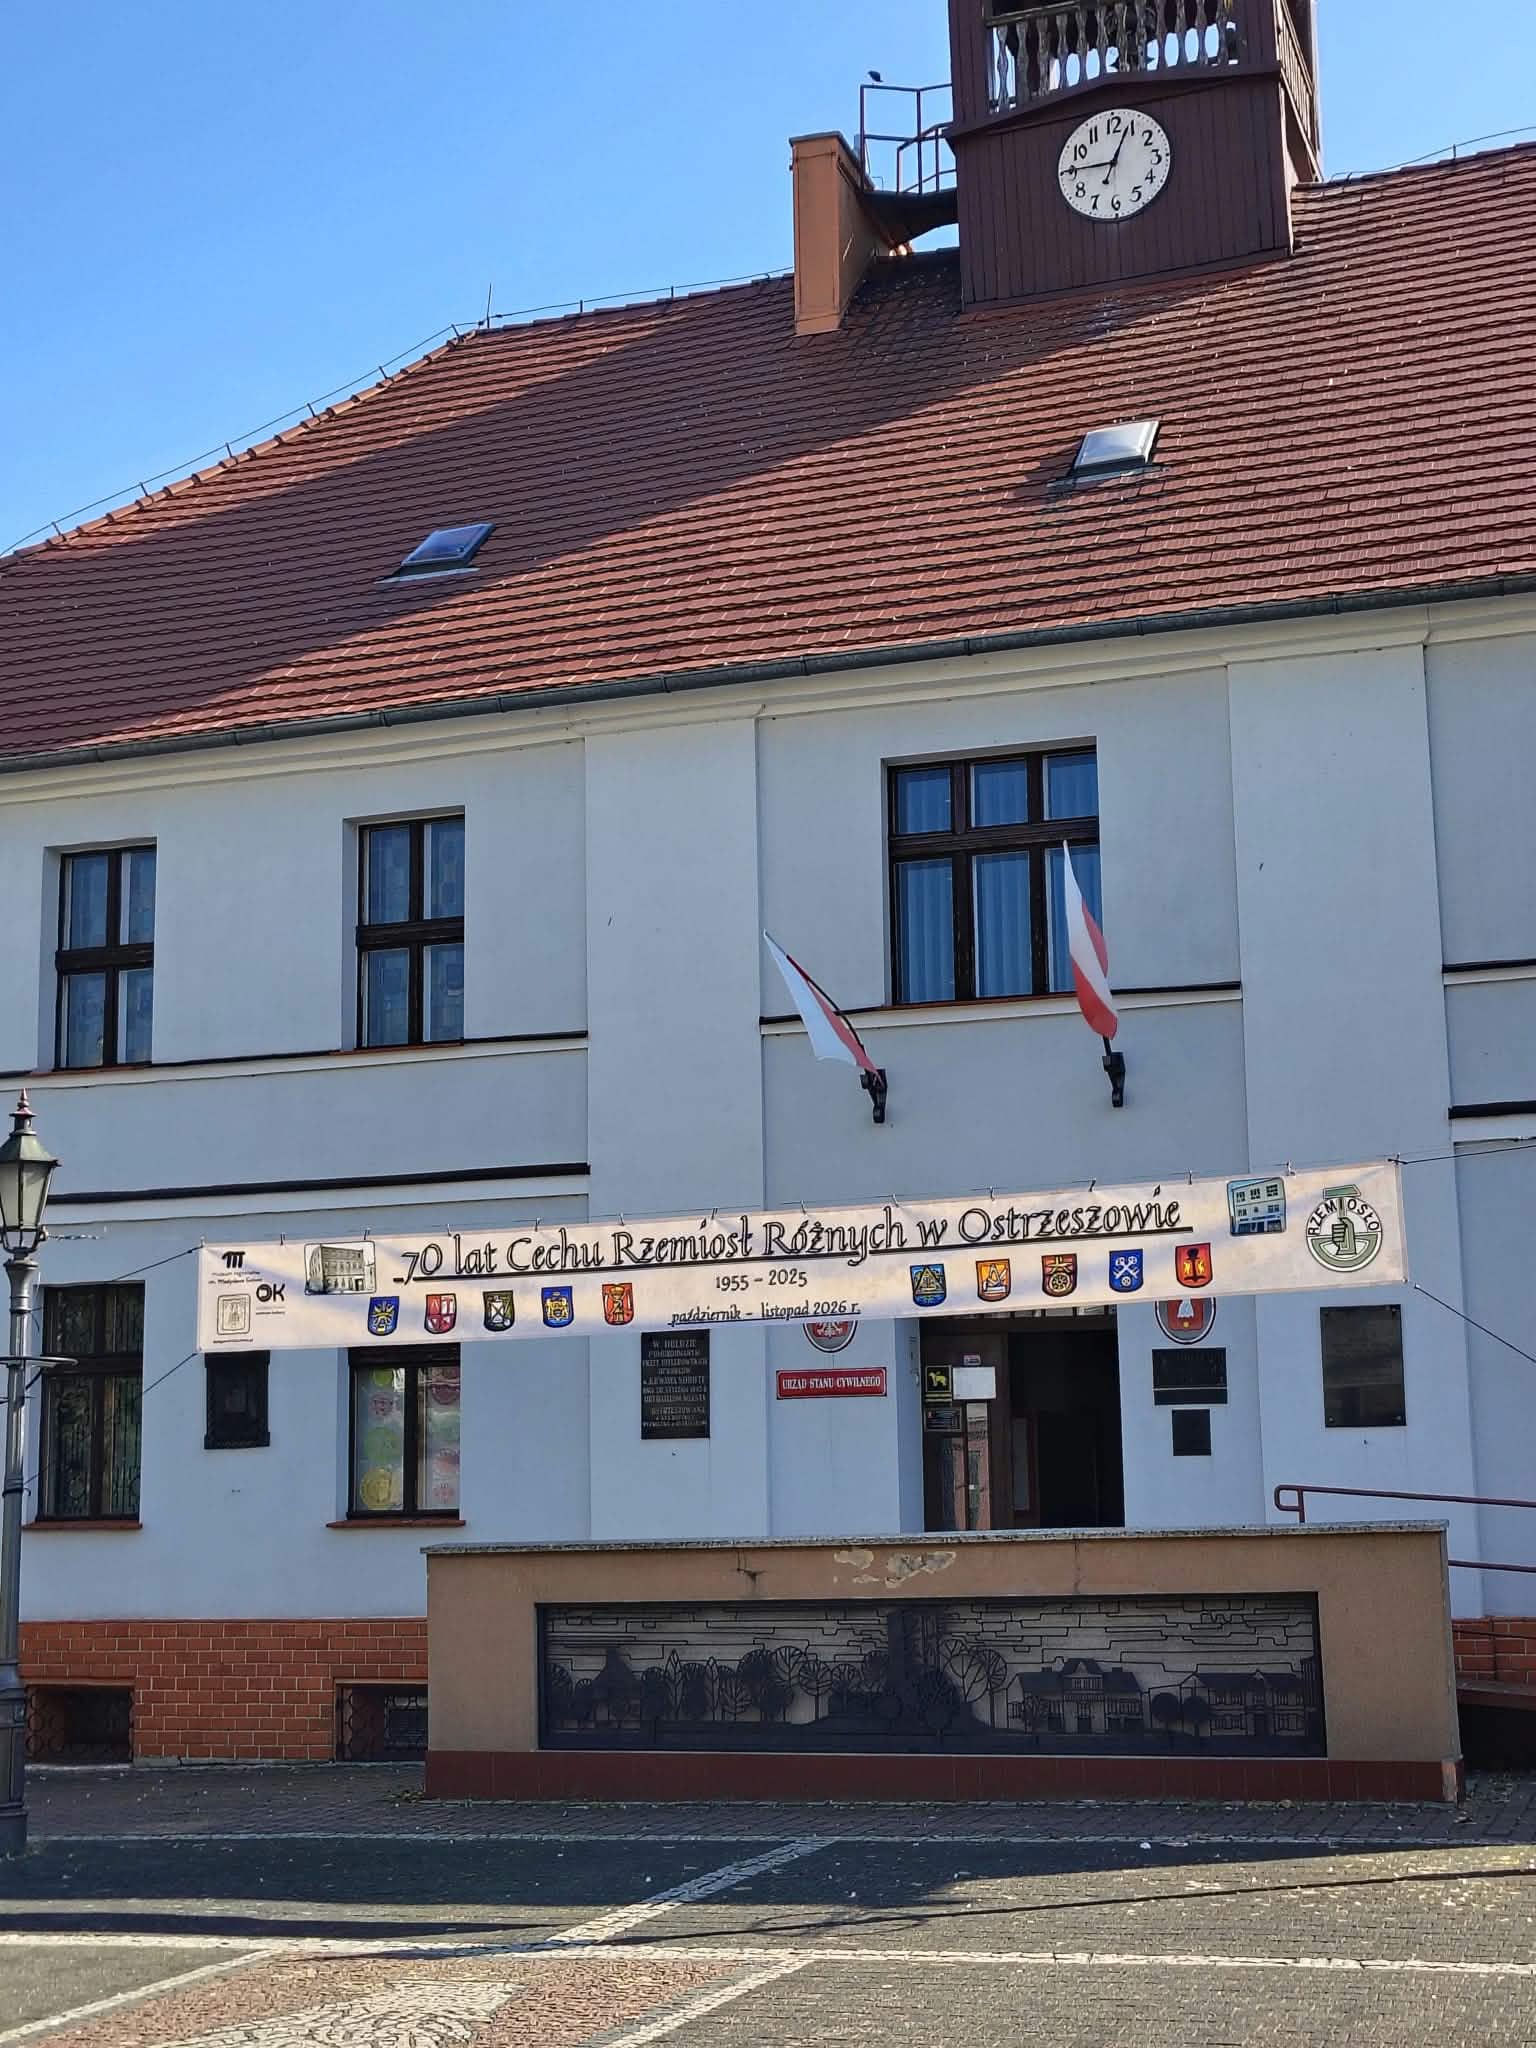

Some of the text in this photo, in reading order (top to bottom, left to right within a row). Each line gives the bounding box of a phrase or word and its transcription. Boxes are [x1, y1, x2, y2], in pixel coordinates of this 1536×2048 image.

[1106, 116, 1121, 135] 12
[1130, 120, 1135, 136] 1
[1089, 125, 1099, 144] 11
[1141, 129, 1153, 146] 2
[1074, 143, 1088, 161] 10
[1150, 149, 1162, 165] 3
[1068, 164, 1079, 180] 9
[1144, 168, 1156, 184] 4
[1075, 181, 1086, 198] 8
[1129, 185, 1142, 202] 5
[1090, 194, 1100, 210] 7
[1111, 194, 1121, 211] 6
[400, 1184, 1181, 1285] 70 lat Cechu Rzemiosł Różnych w Ostrzeszowie
[715, 1274, 750, 1292] 1955
[768, 1267, 808, 1288] 2025
[671, 1303, 742, 1327] październik
[761, 1299, 809, 1321] listopad
[813, 1301, 847, 1315] 2026
[783, 1376, 881, 1390] URZĄD STANU CYWILNEGO
